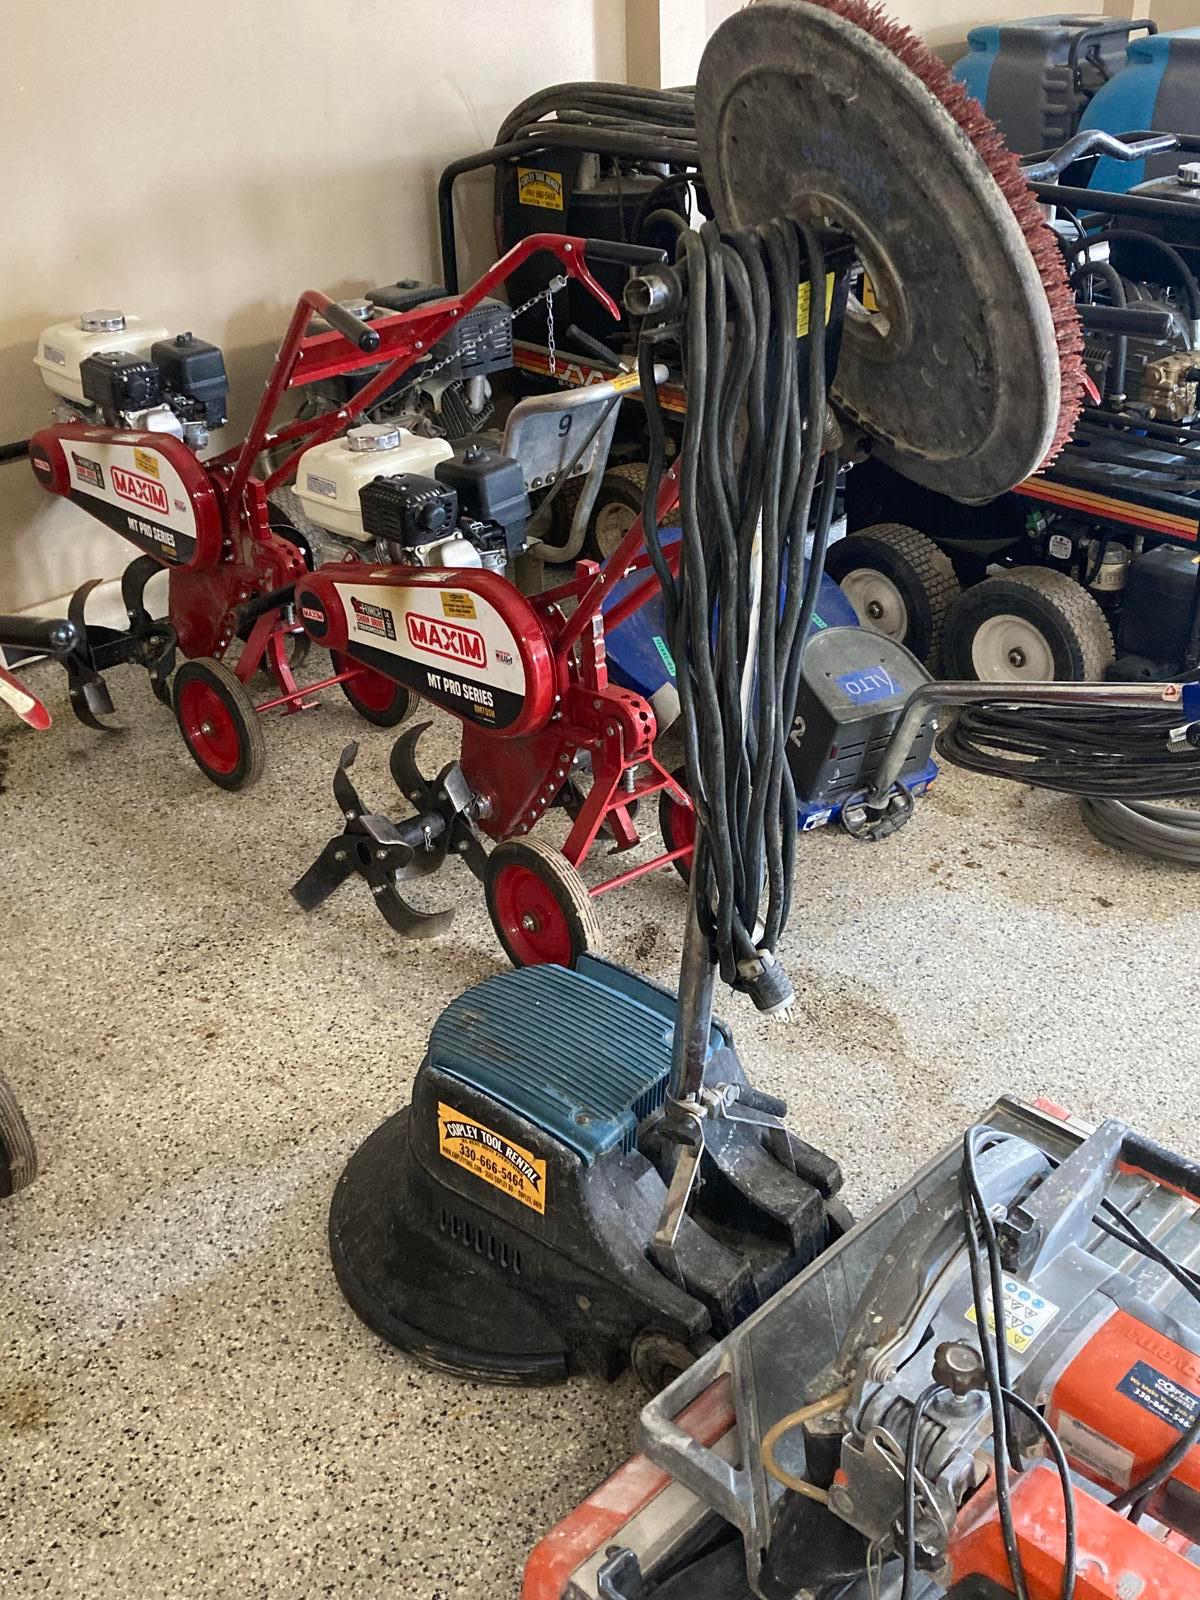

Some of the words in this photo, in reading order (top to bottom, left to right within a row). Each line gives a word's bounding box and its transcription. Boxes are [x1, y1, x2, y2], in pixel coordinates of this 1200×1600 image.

[558, 413, 573, 438] 9
[113, 470, 166, 511] MAXIM
[127, 516, 140, 532] MT
[139, 521, 153, 538] PRO
[152, 525, 176, 547] SERIES
[409, 616, 482, 662] MAXIM
[426, 671, 442, 690] MT
[442, 676, 462, 697] PRO
[462, 683, 494, 707] SERIES
[845, 665, 895, 696] ALTO
[789, 715, 807, 749] 2
[446, 1122, 479, 1140] COPLEY
[480, 1130, 503, 1153] TOOL
[505, 1146, 540, 1184] RENTAL
[459, 1142, 525, 1190] 330-666-5464
[1156, 1378, 1200, 1408] COPLEY
